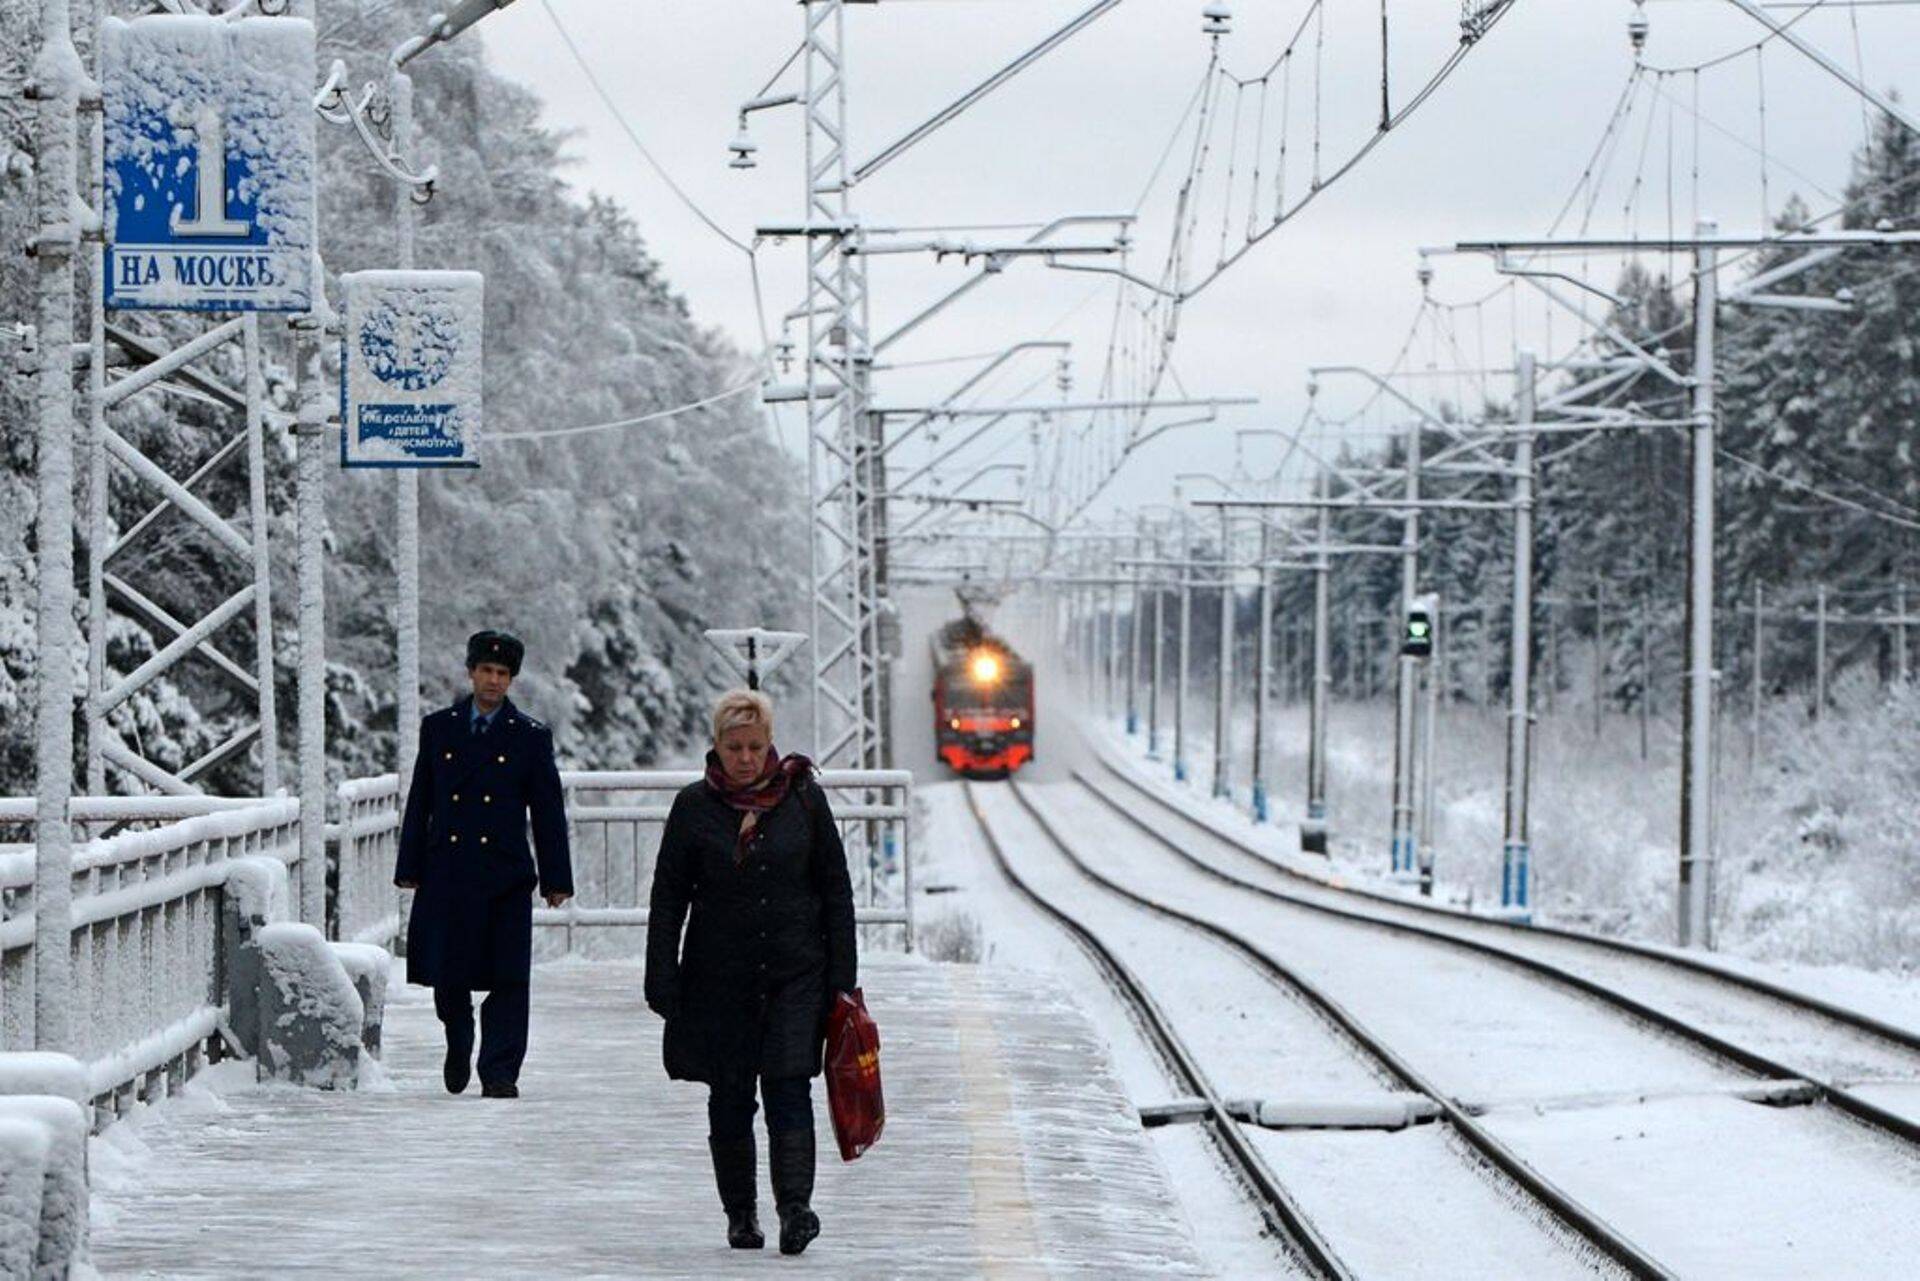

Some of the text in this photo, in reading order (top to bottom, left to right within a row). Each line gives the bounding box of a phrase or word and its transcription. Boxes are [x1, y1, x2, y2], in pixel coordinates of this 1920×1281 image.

[169, 104, 250, 237] 1
[120, 254, 288, 287] НА МОСКВ
